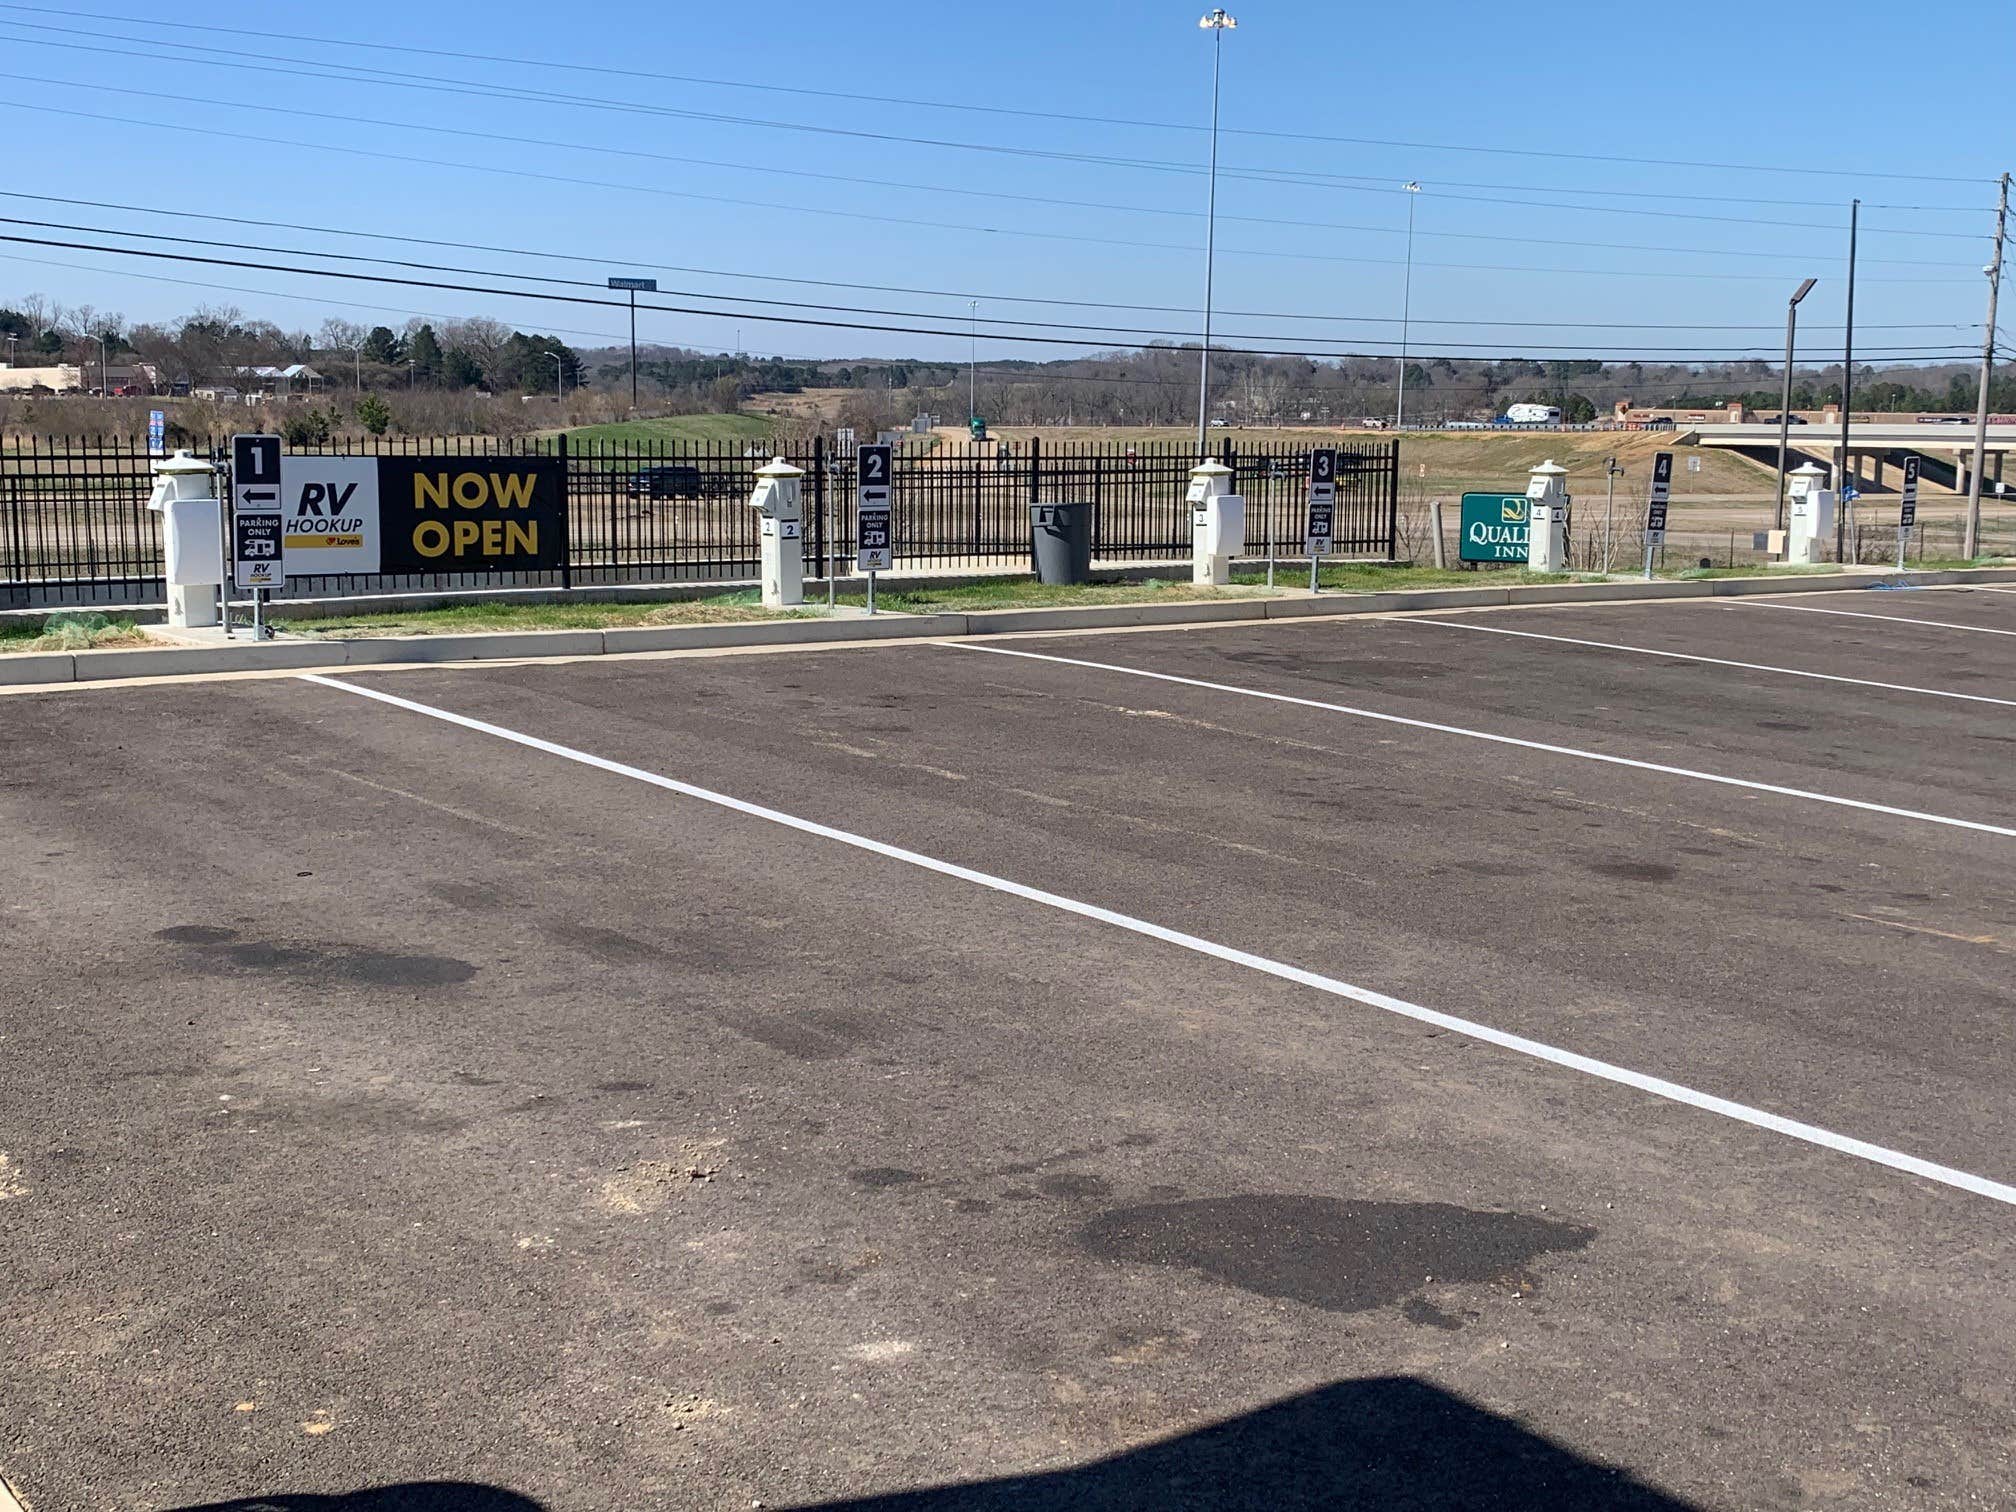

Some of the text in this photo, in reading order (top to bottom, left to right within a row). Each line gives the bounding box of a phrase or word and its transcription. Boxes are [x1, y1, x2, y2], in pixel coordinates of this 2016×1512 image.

[250, 446, 263, 475] 1
[867, 454, 883, 478] 2
[1318, 455, 1329, 477] 3
[1658, 459, 1668, 477] 4
[1907, 462, 1916, 479] 5
[297, 482, 359, 516] RV
[414, 472, 538, 509] NOW
[239, 518, 280, 528] PARKING
[286, 518, 363, 533] HOOKUP
[786, 524, 794, 535] 2
[247, 528, 271, 536] ONLY
[412, 520, 539, 558] OPEN
[1469, 521, 1530, 546] QUALI
[869, 550, 882, 560] RV
[1494, 545, 1529, 558] INN
[253, 563, 270, 573] RV
